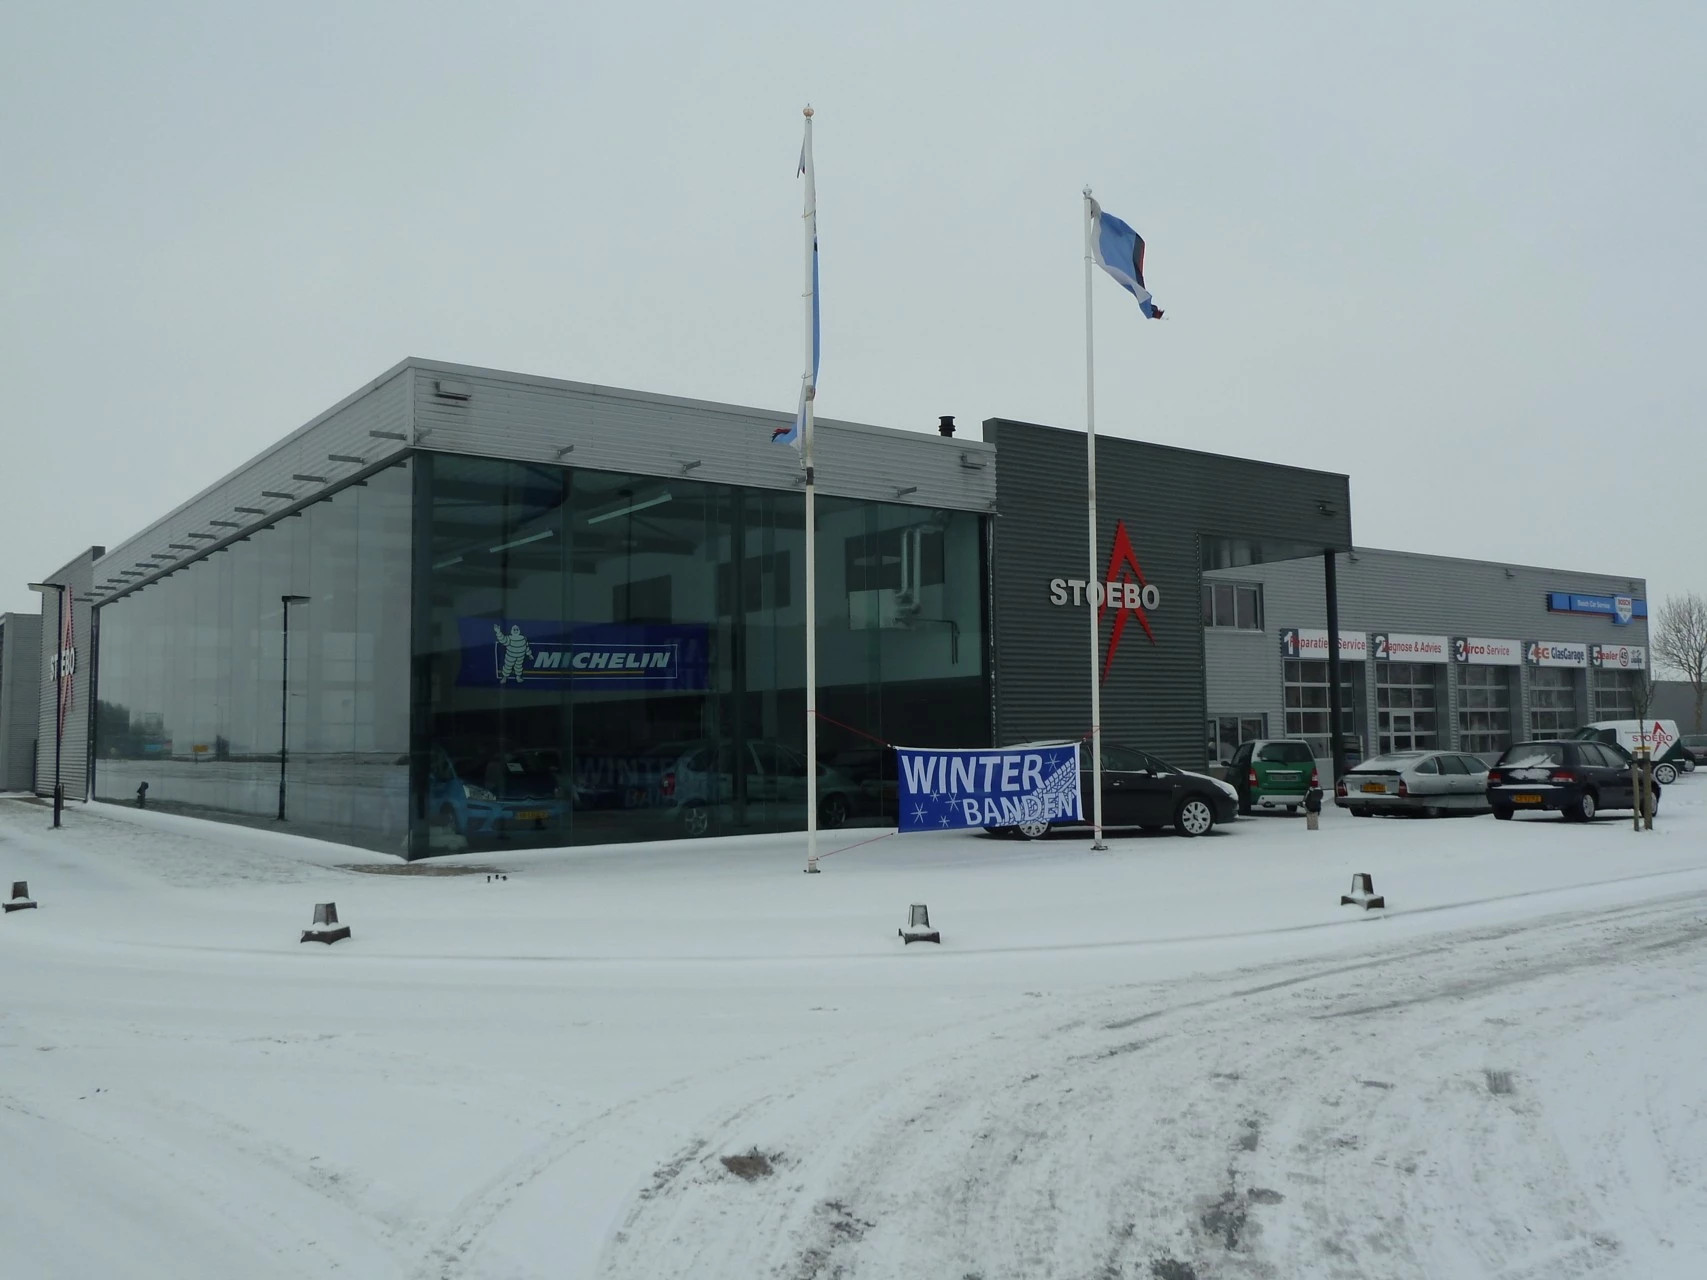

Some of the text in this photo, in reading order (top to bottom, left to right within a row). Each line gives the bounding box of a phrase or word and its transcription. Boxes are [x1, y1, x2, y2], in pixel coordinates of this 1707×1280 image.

[1050, 578, 1160, 610] STOEBO
[1283, 631, 1294, 655] 1
[1337, 636, 1366, 650] Service
[1375, 635, 1388, 658] 2
[1414, 641, 1419, 652] &
[1420, 641, 1442, 654] Advies
[1455, 640, 1467, 661] 3
[1486, 644, 1510, 656] Service
[1527, 643, 1539, 664] 4
[50, 647, 75, 681] STEBO
[533, 651, 671, 669] MICHELIN
[1551, 646, 1585, 663] GlasGarage
[1592, 646, 1602, 666] 5
[901, 754, 1047, 794] WINTER
[963, 792, 1074, 826] BANDEN
